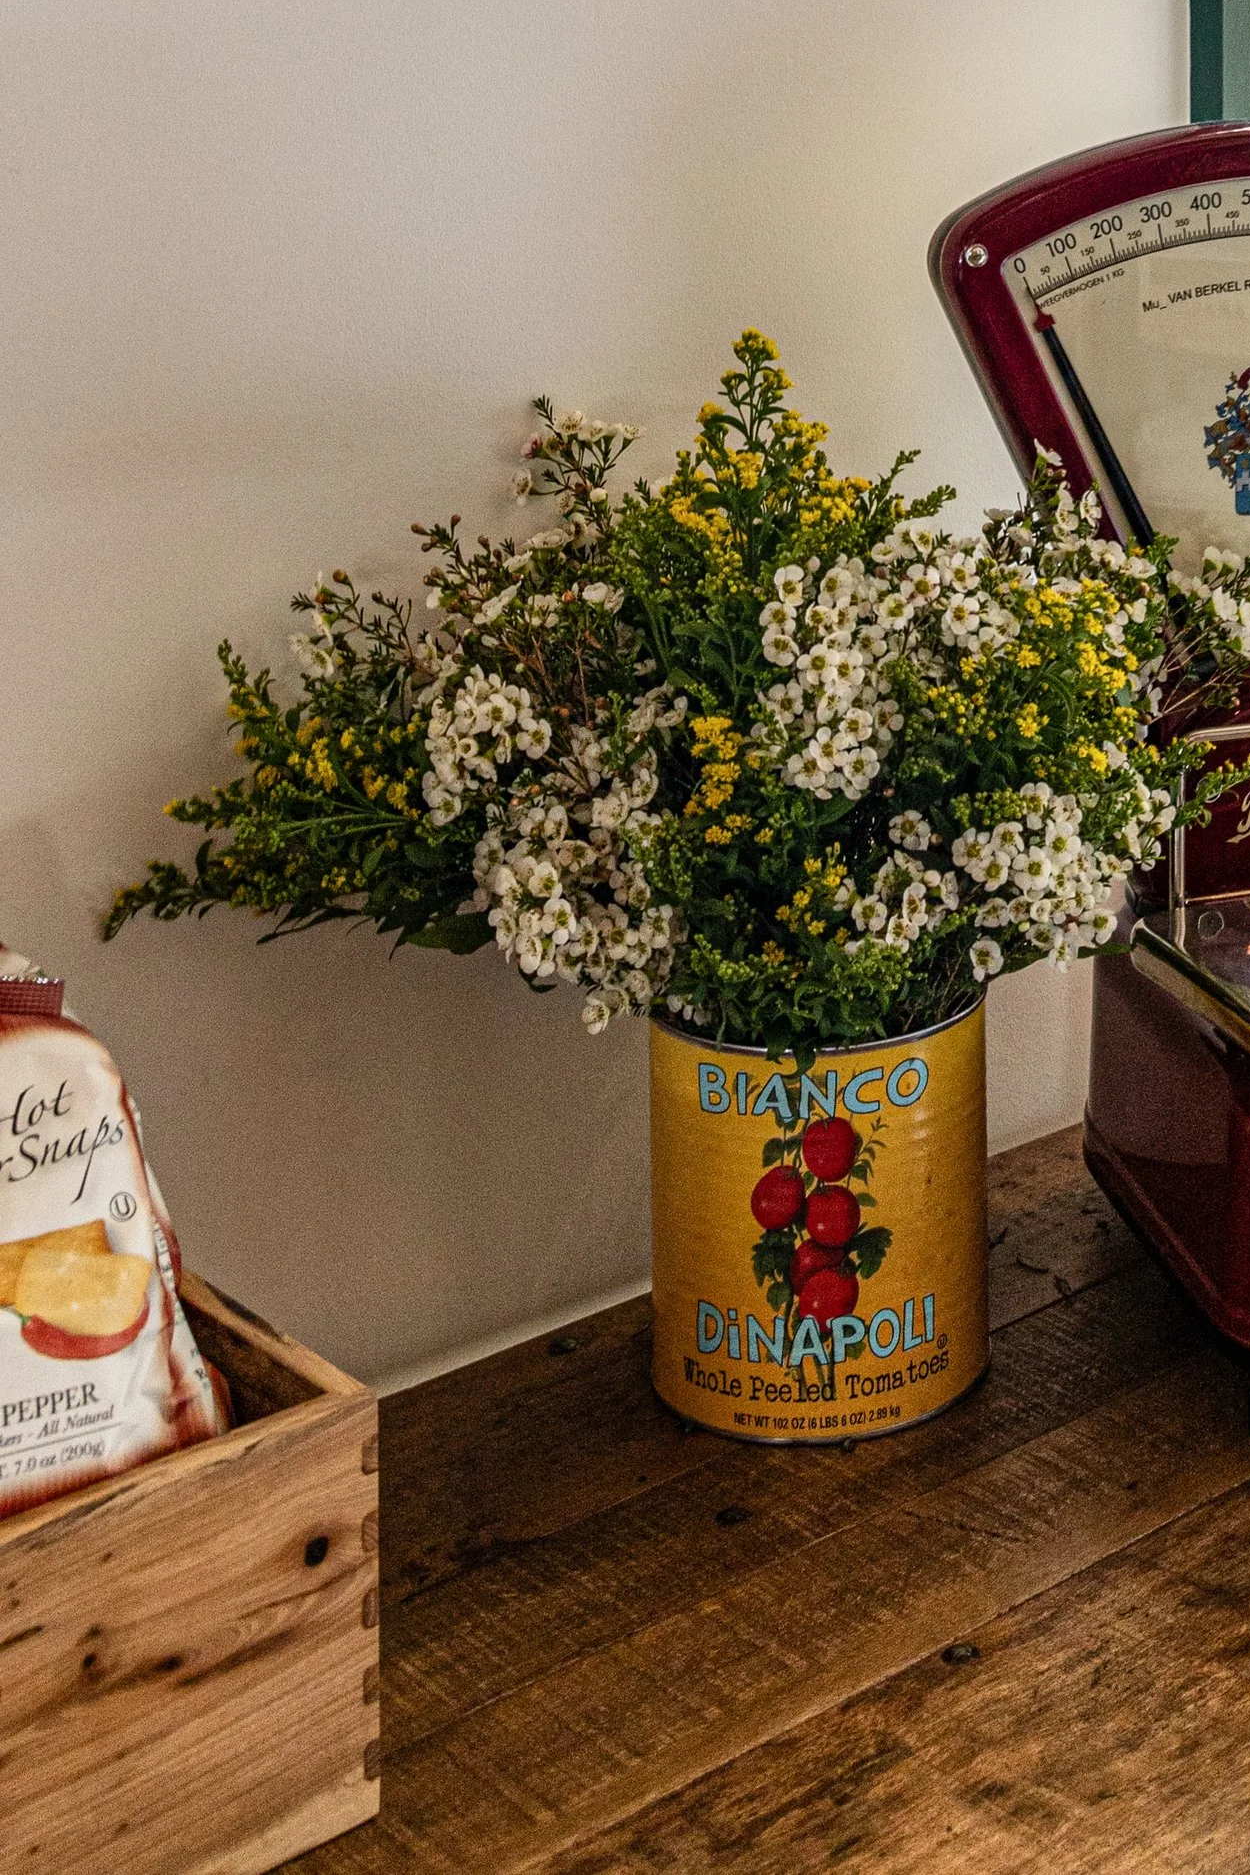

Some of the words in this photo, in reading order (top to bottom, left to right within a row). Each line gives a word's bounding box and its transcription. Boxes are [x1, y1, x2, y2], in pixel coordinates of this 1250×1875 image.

[1013, 257, 1026, 274] 0
[1045, 233, 1077, 258] 100
[1090, 215, 1123, 239] 200
[1139, 201, 1172, 223] 300
[1190, 192, 1222, 212] 400
[1040, 265, 1051, 275] 50
[1080, 246, 1095, 257] 150
[1127, 229, 1142, 241] 250
[1175, 218, 1190, 227] 350
[1225, 210, 1240, 219] 450
[1168, 288, 1192, 304] VAN
[1195, 280, 1242, 298] BERKEL
[697, 1057, 930, 1124] BIANCO
[683, 1357, 742, 1398] Whole
[749, 1375, 837, 1403] Peeled
[845, 1350, 949, 1399] Tomatoes
[2, 1382, 100, 1427] PEPPER
[37, 1418, 60, 1440] All
[63, 1403, 114, 1434] Natural
[734, 1412, 753, 1426] NET
[754, 1416, 770, 1428] WT
[773, 1417, 788, 1429] 102
[791, 1417, 806, 1430] OZ
[819, 1415, 838, 1429] LBS
[889, 1404, 901, 1418] kg
